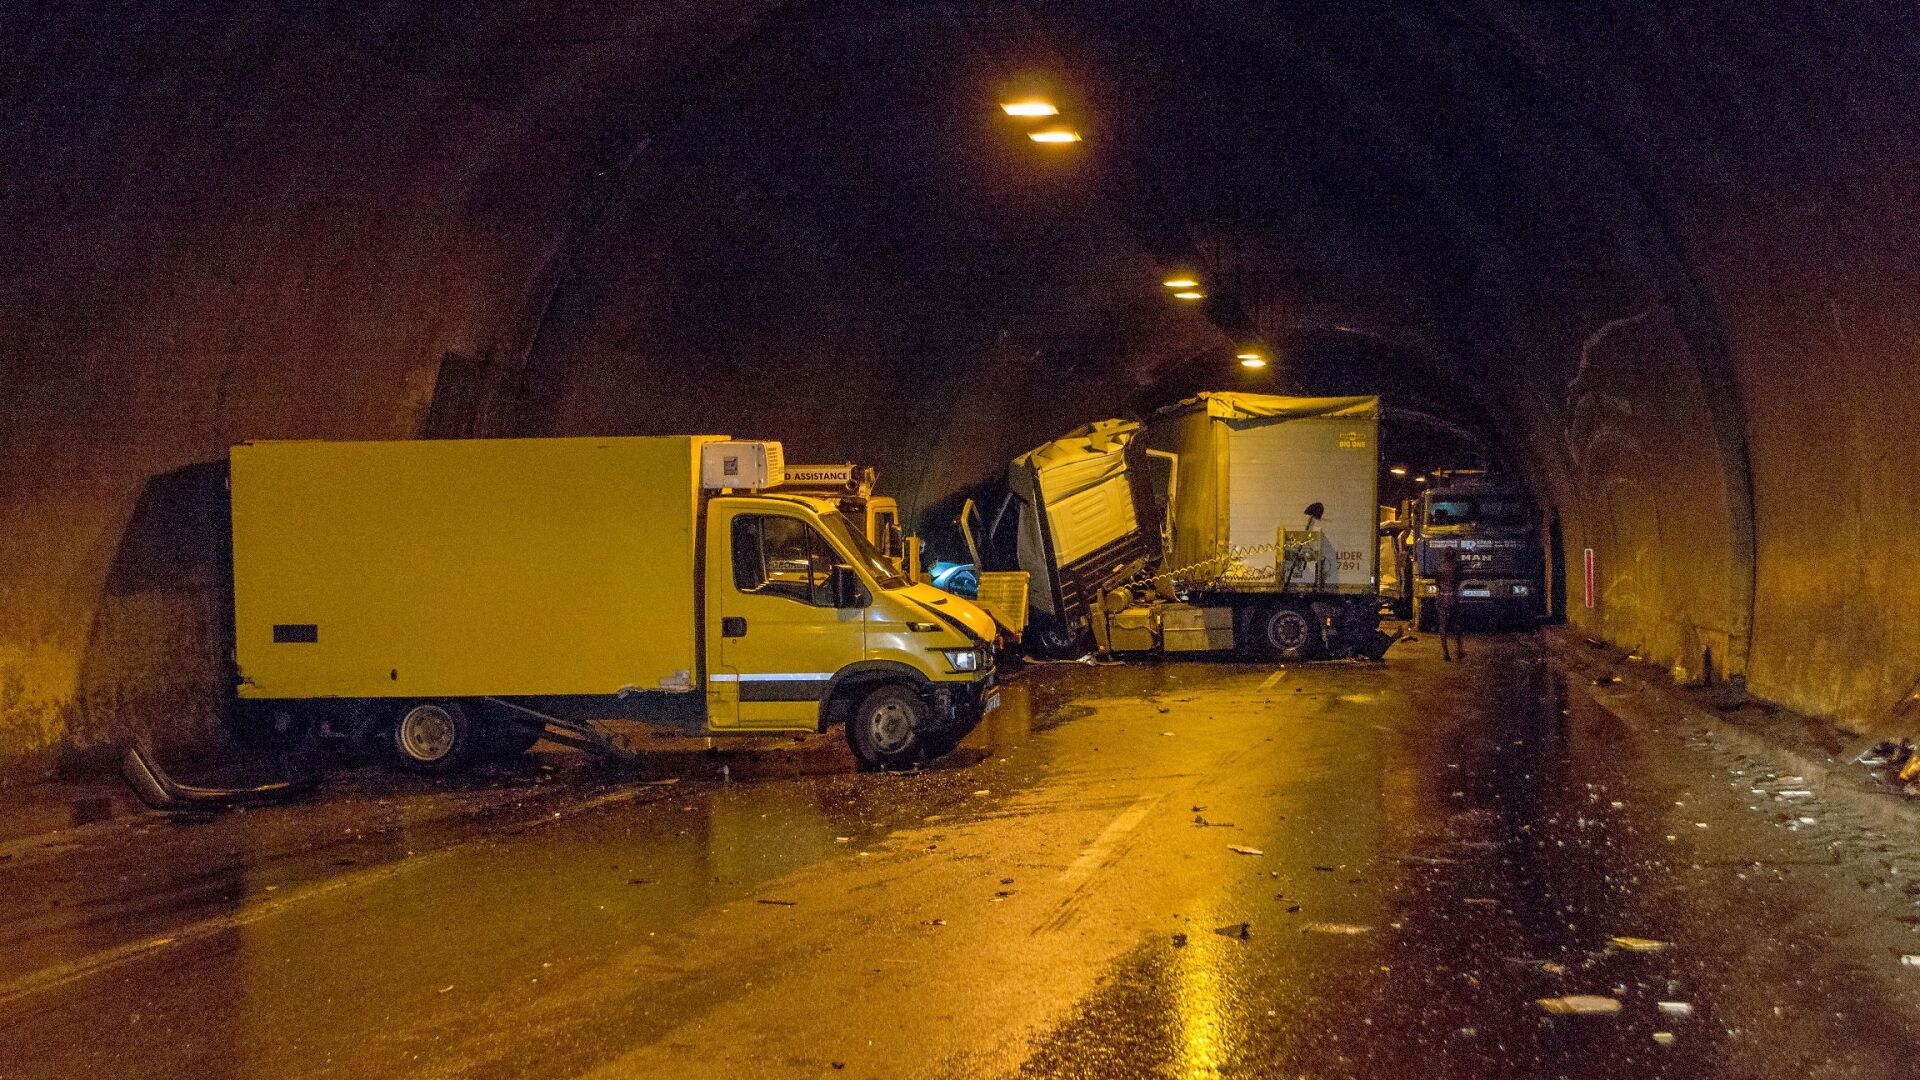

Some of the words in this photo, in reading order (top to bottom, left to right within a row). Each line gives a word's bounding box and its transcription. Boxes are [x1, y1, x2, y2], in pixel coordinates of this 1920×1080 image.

[1335, 551, 1362, 560] LIDER
[1460, 554, 1492, 562] MAN
[1336, 561, 1360, 570] 7891
